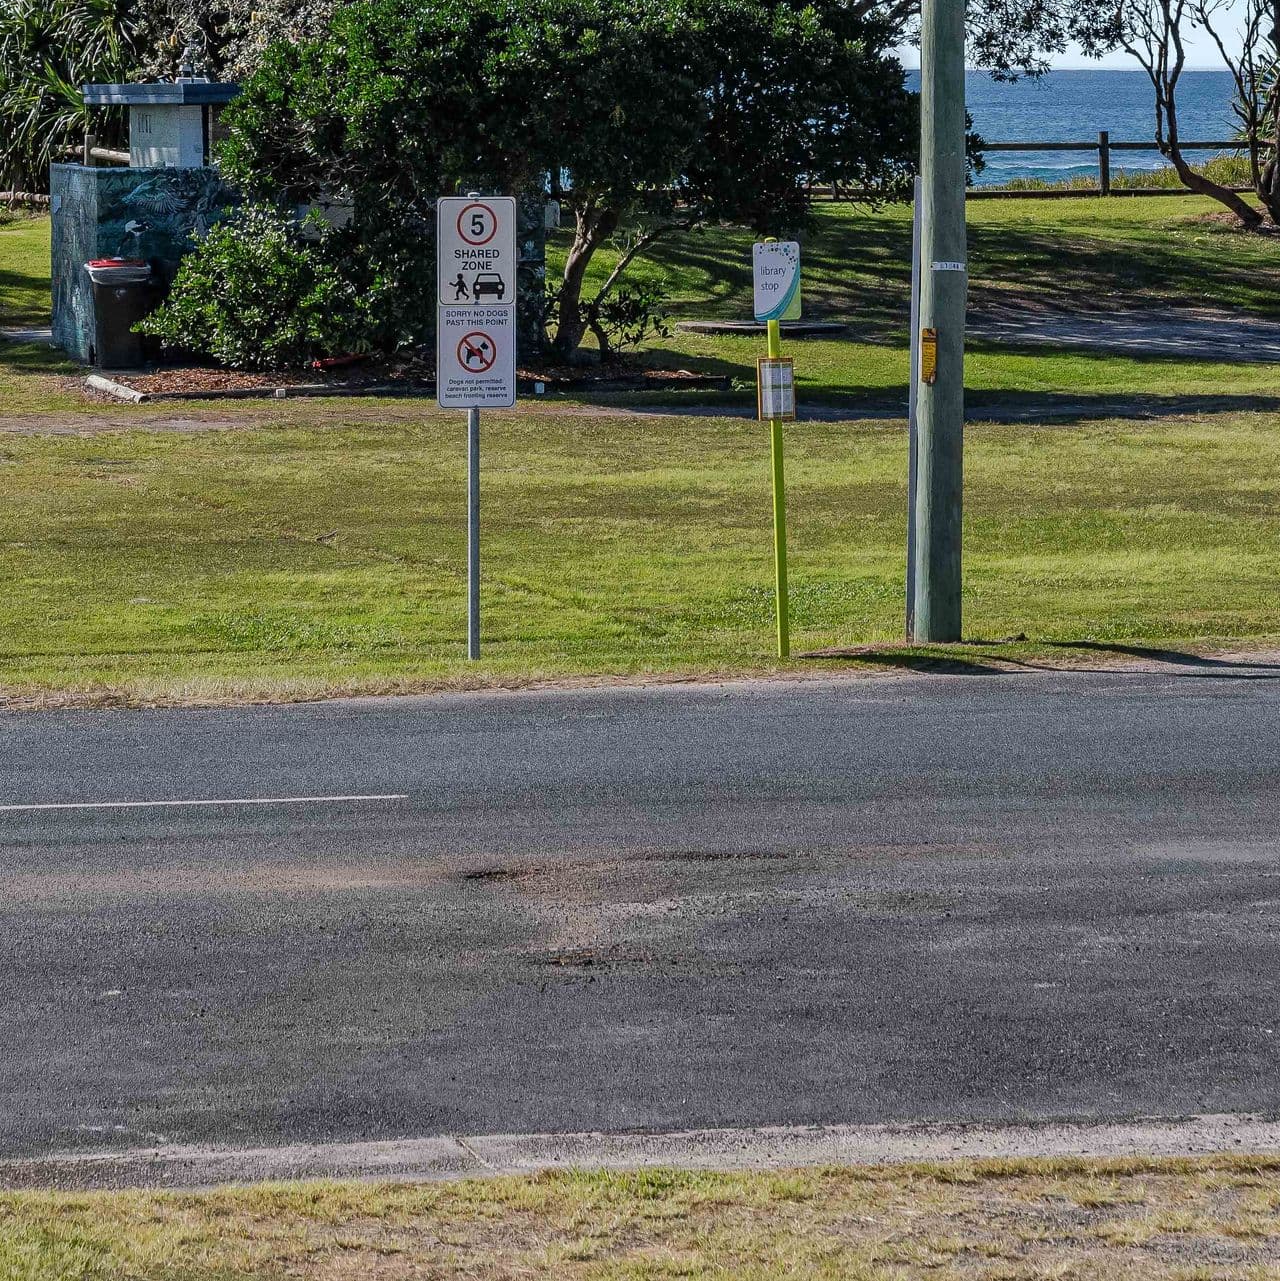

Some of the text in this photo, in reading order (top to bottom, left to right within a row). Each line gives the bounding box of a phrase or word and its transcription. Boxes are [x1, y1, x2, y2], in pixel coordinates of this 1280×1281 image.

[471, 214, 484, 236] 5
[454, 249, 500, 259] SHARED
[461, 261, 492, 270] ZONE
[760, 266, 786, 277] library
[760, 281, 779, 292] stop
[445, 310, 472, 318] SORRY
